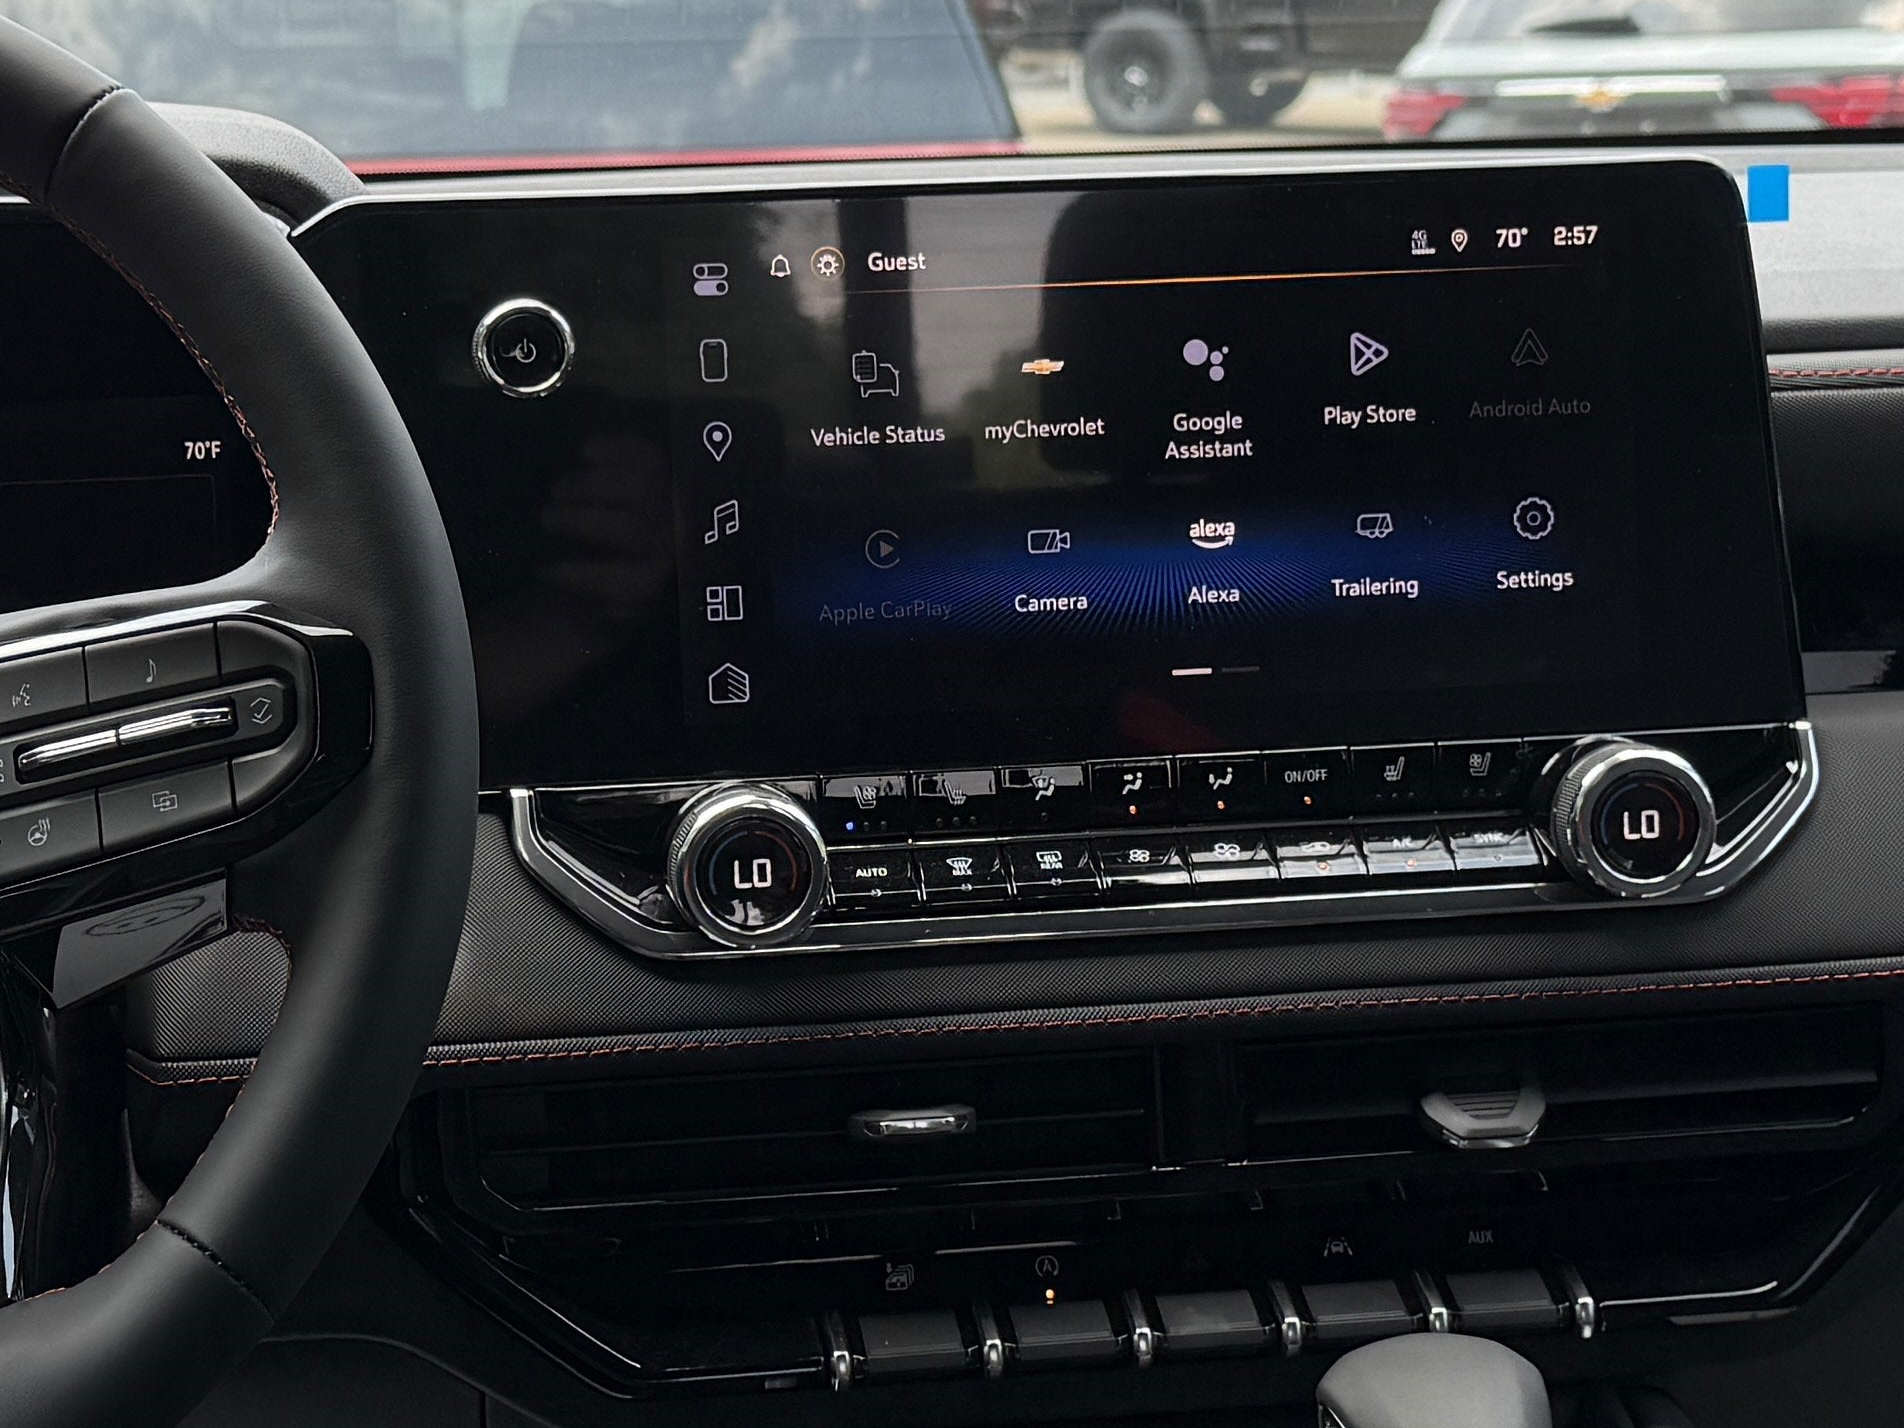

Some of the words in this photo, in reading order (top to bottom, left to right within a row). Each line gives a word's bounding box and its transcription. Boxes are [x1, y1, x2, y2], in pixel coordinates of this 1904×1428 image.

[1496, 227, 1528, 248] 70°
[1553, 225, 1598, 247] 2:57
[867, 251, 927, 271] Guest
[1323, 406, 1364, 429] Play
[1366, 405, 1417, 425] Store
[1469, 395, 1545, 420] Android
[1548, 396, 1591, 415] Auto
[984, 418, 1106, 442] myChevrolet
[1173, 411, 1243, 436] Google
[810, 426, 880, 448] Vehicle
[884, 423, 946, 445] Status
[183, 440, 221, 460] 70°F
[1165, 438, 1254, 460] Assistant
[1189, 518, 1235, 538] alexa
[1331, 576, 1419, 598] Trailering
[1497, 569, 1574, 591] Settings
[1014, 593, 1089, 613] Camera
[1188, 584, 1240, 604] Alexa
[819, 601, 875, 625] Apple
[880, 598, 952, 619] CarPlay
[1284, 768, 1328, 783] ON/OFF
[1623, 810, 1660, 841] LO
[733, 858, 772, 890] LO
[855, 866, 888, 878] AUTO
[1467, 1229, 1495, 1244] AUX
